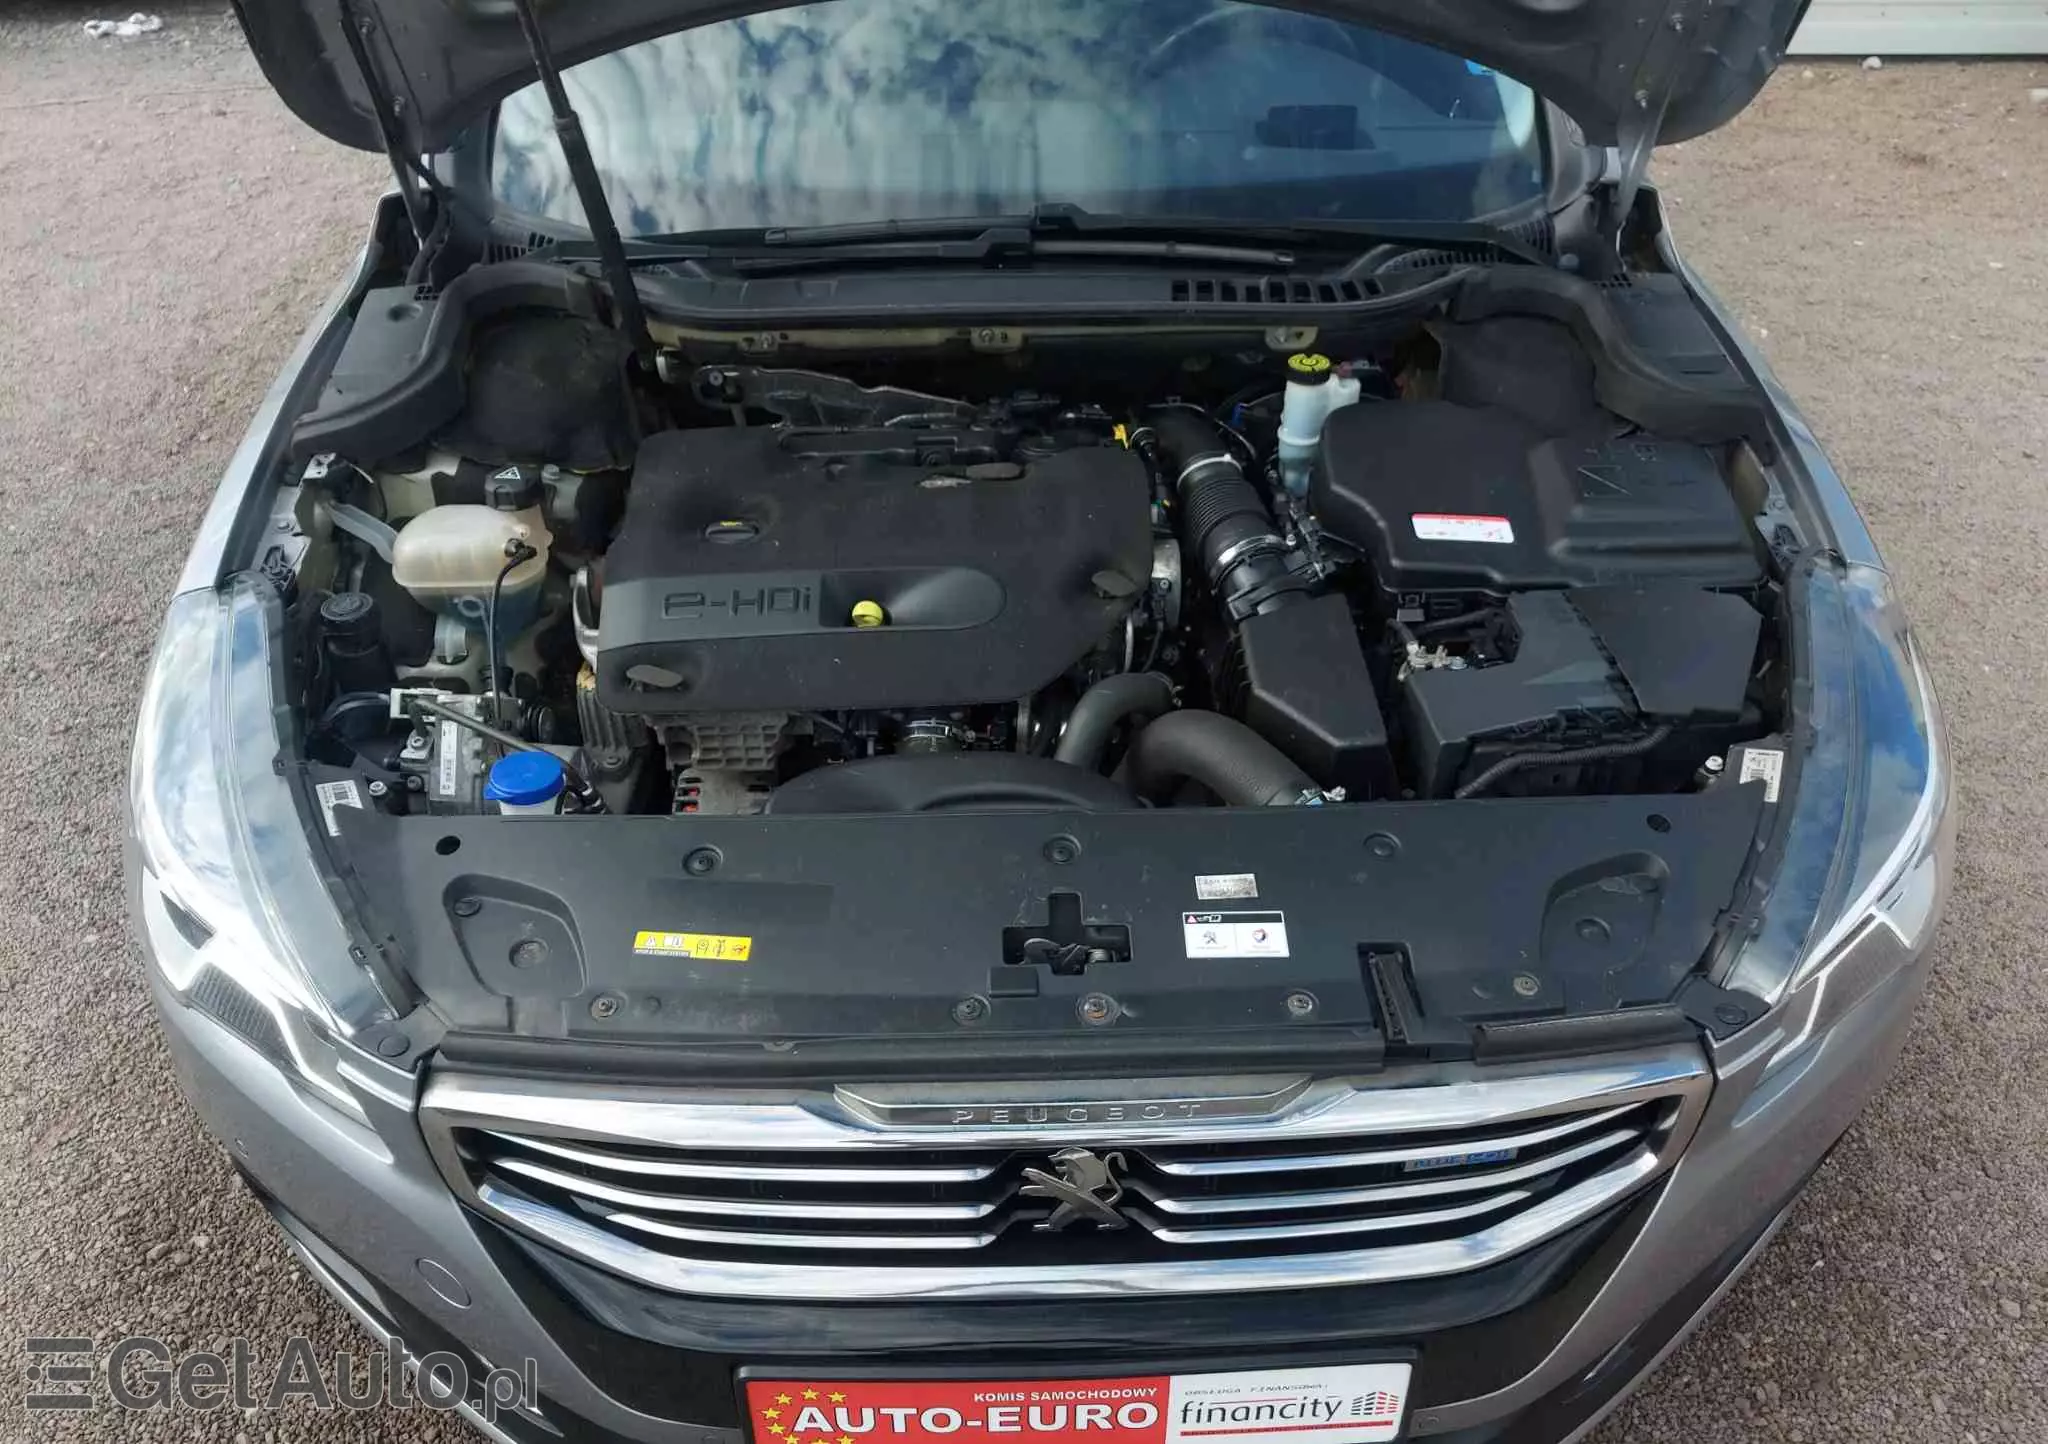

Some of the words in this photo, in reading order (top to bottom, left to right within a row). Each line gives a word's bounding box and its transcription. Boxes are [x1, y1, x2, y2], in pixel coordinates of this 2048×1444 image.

[952, 1104, 1201, 1123] PEUGEOT
[973, 1391, 1026, 1402] KOMIS
[1030, 1387, 1158, 1401] SAMOCHODOWY
[792, 1401, 1160, 1434] AUTO-EURO
[1180, 1396, 1342, 1424] financity
